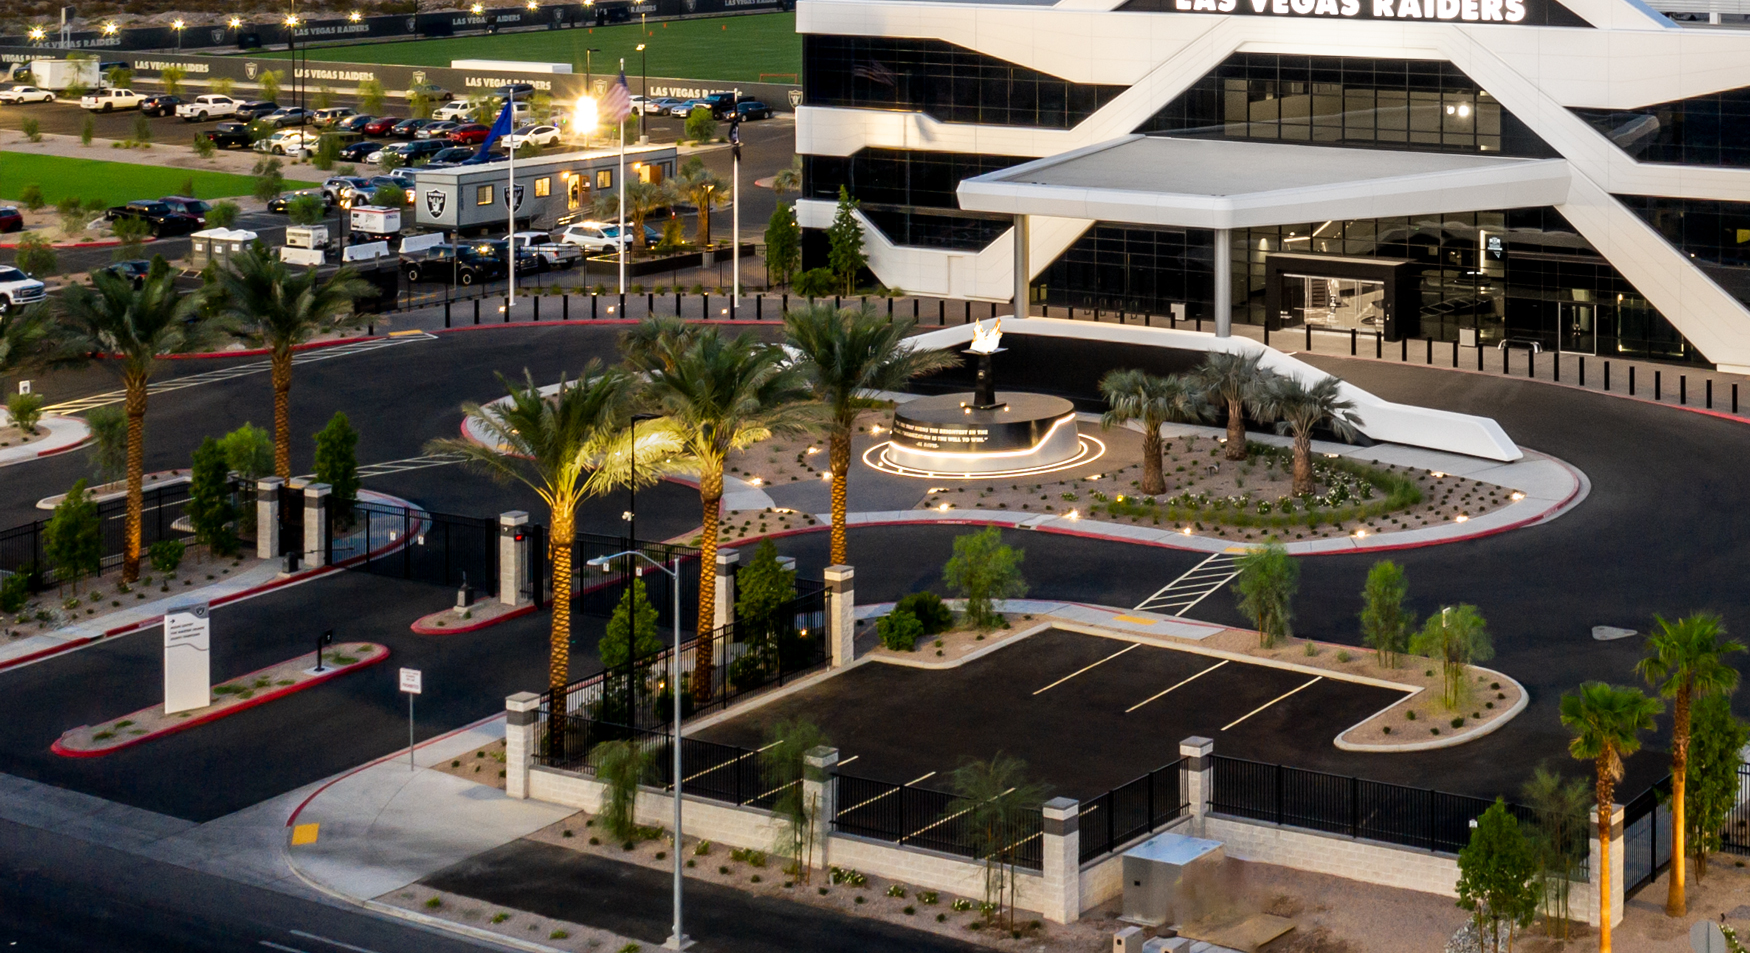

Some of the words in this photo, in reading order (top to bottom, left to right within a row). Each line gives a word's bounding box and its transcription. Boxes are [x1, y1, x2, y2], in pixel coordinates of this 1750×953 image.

[295, 28, 309, 36] LAS
[310, 27, 335, 35] VEGAS
[337, 24, 369, 33] RAIDERS
[1, 53, 24, 62] VEGAS
[135, 60, 149, 69] LAS
[150, 61, 175, 70] VEGAS
[176, 63, 209, 73] RAIDERS
[294, 68, 309, 78] LAS
[311, 70, 337, 79] VEGAS
[338, 71, 374, 81] RAIDERS
[465, 77, 482, 86] LAS
[483, 78, 512, 87] VEGAS
[650, 87, 668, 96] LAS
[669, 88, 700, 98] VEGAS
